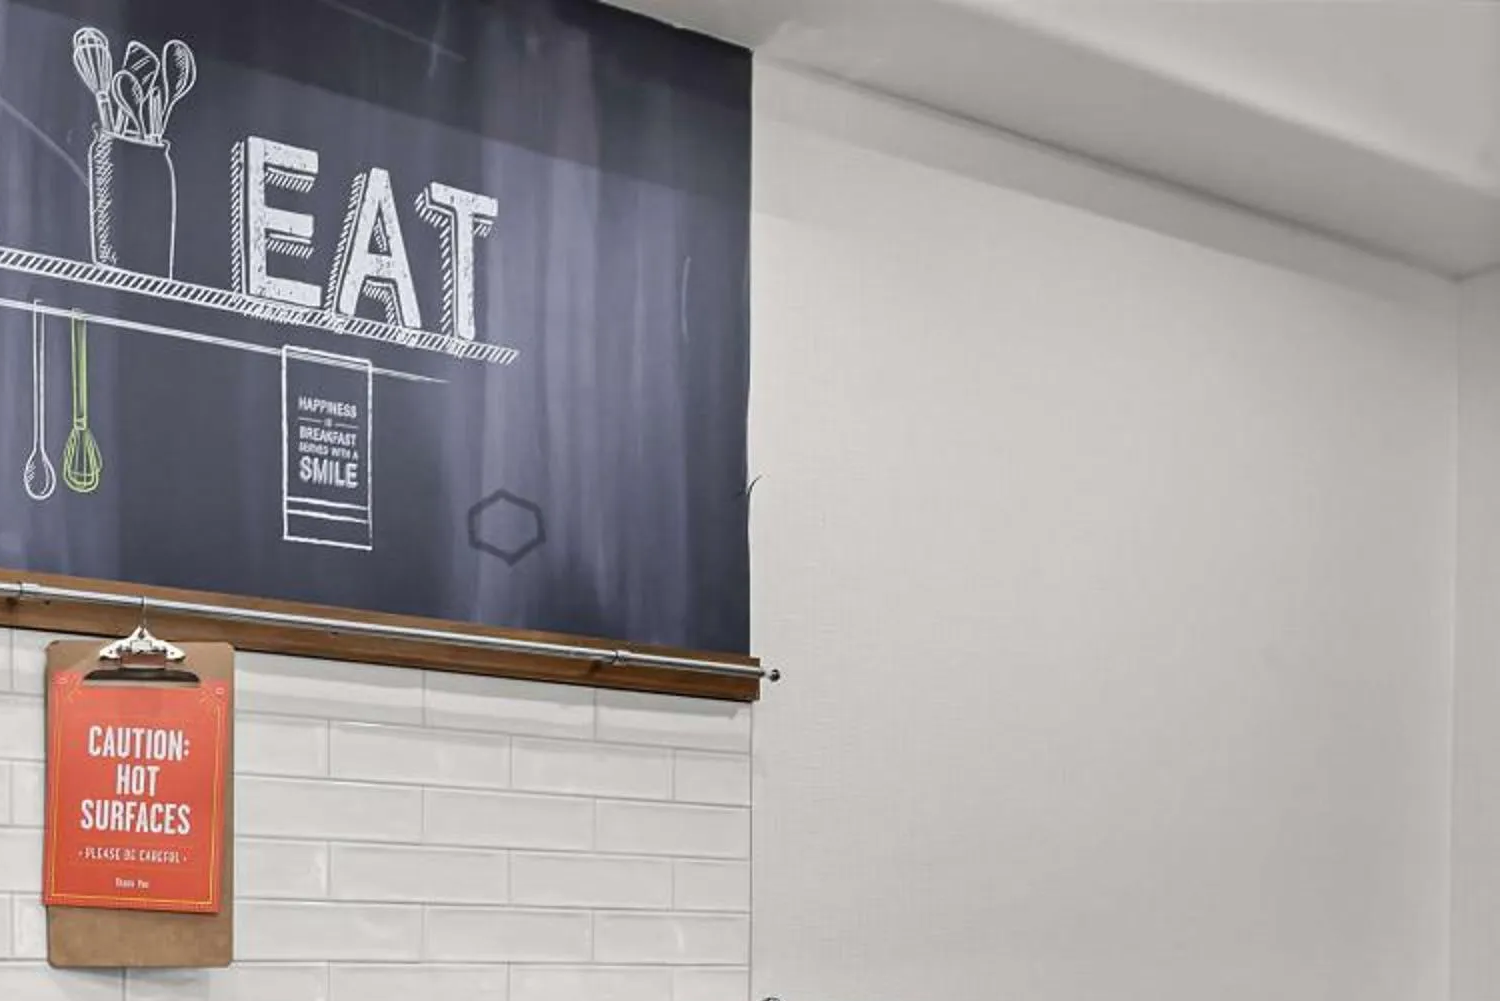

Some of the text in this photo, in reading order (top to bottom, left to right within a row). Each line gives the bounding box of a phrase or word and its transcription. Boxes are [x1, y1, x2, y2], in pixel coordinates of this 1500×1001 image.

[231, 135, 499, 341] EAT
[298, 396, 357, 418] HAPPINESS
[299, 426, 357, 447] BREAKFAST
[299, 455, 359, 489] SMILE
[88, 725, 190, 761] CAUTION:
[115, 764, 160, 797] HOT
[80, 799, 191, 835] SURFACES
[85, 847, 120, 861] PLEASE
